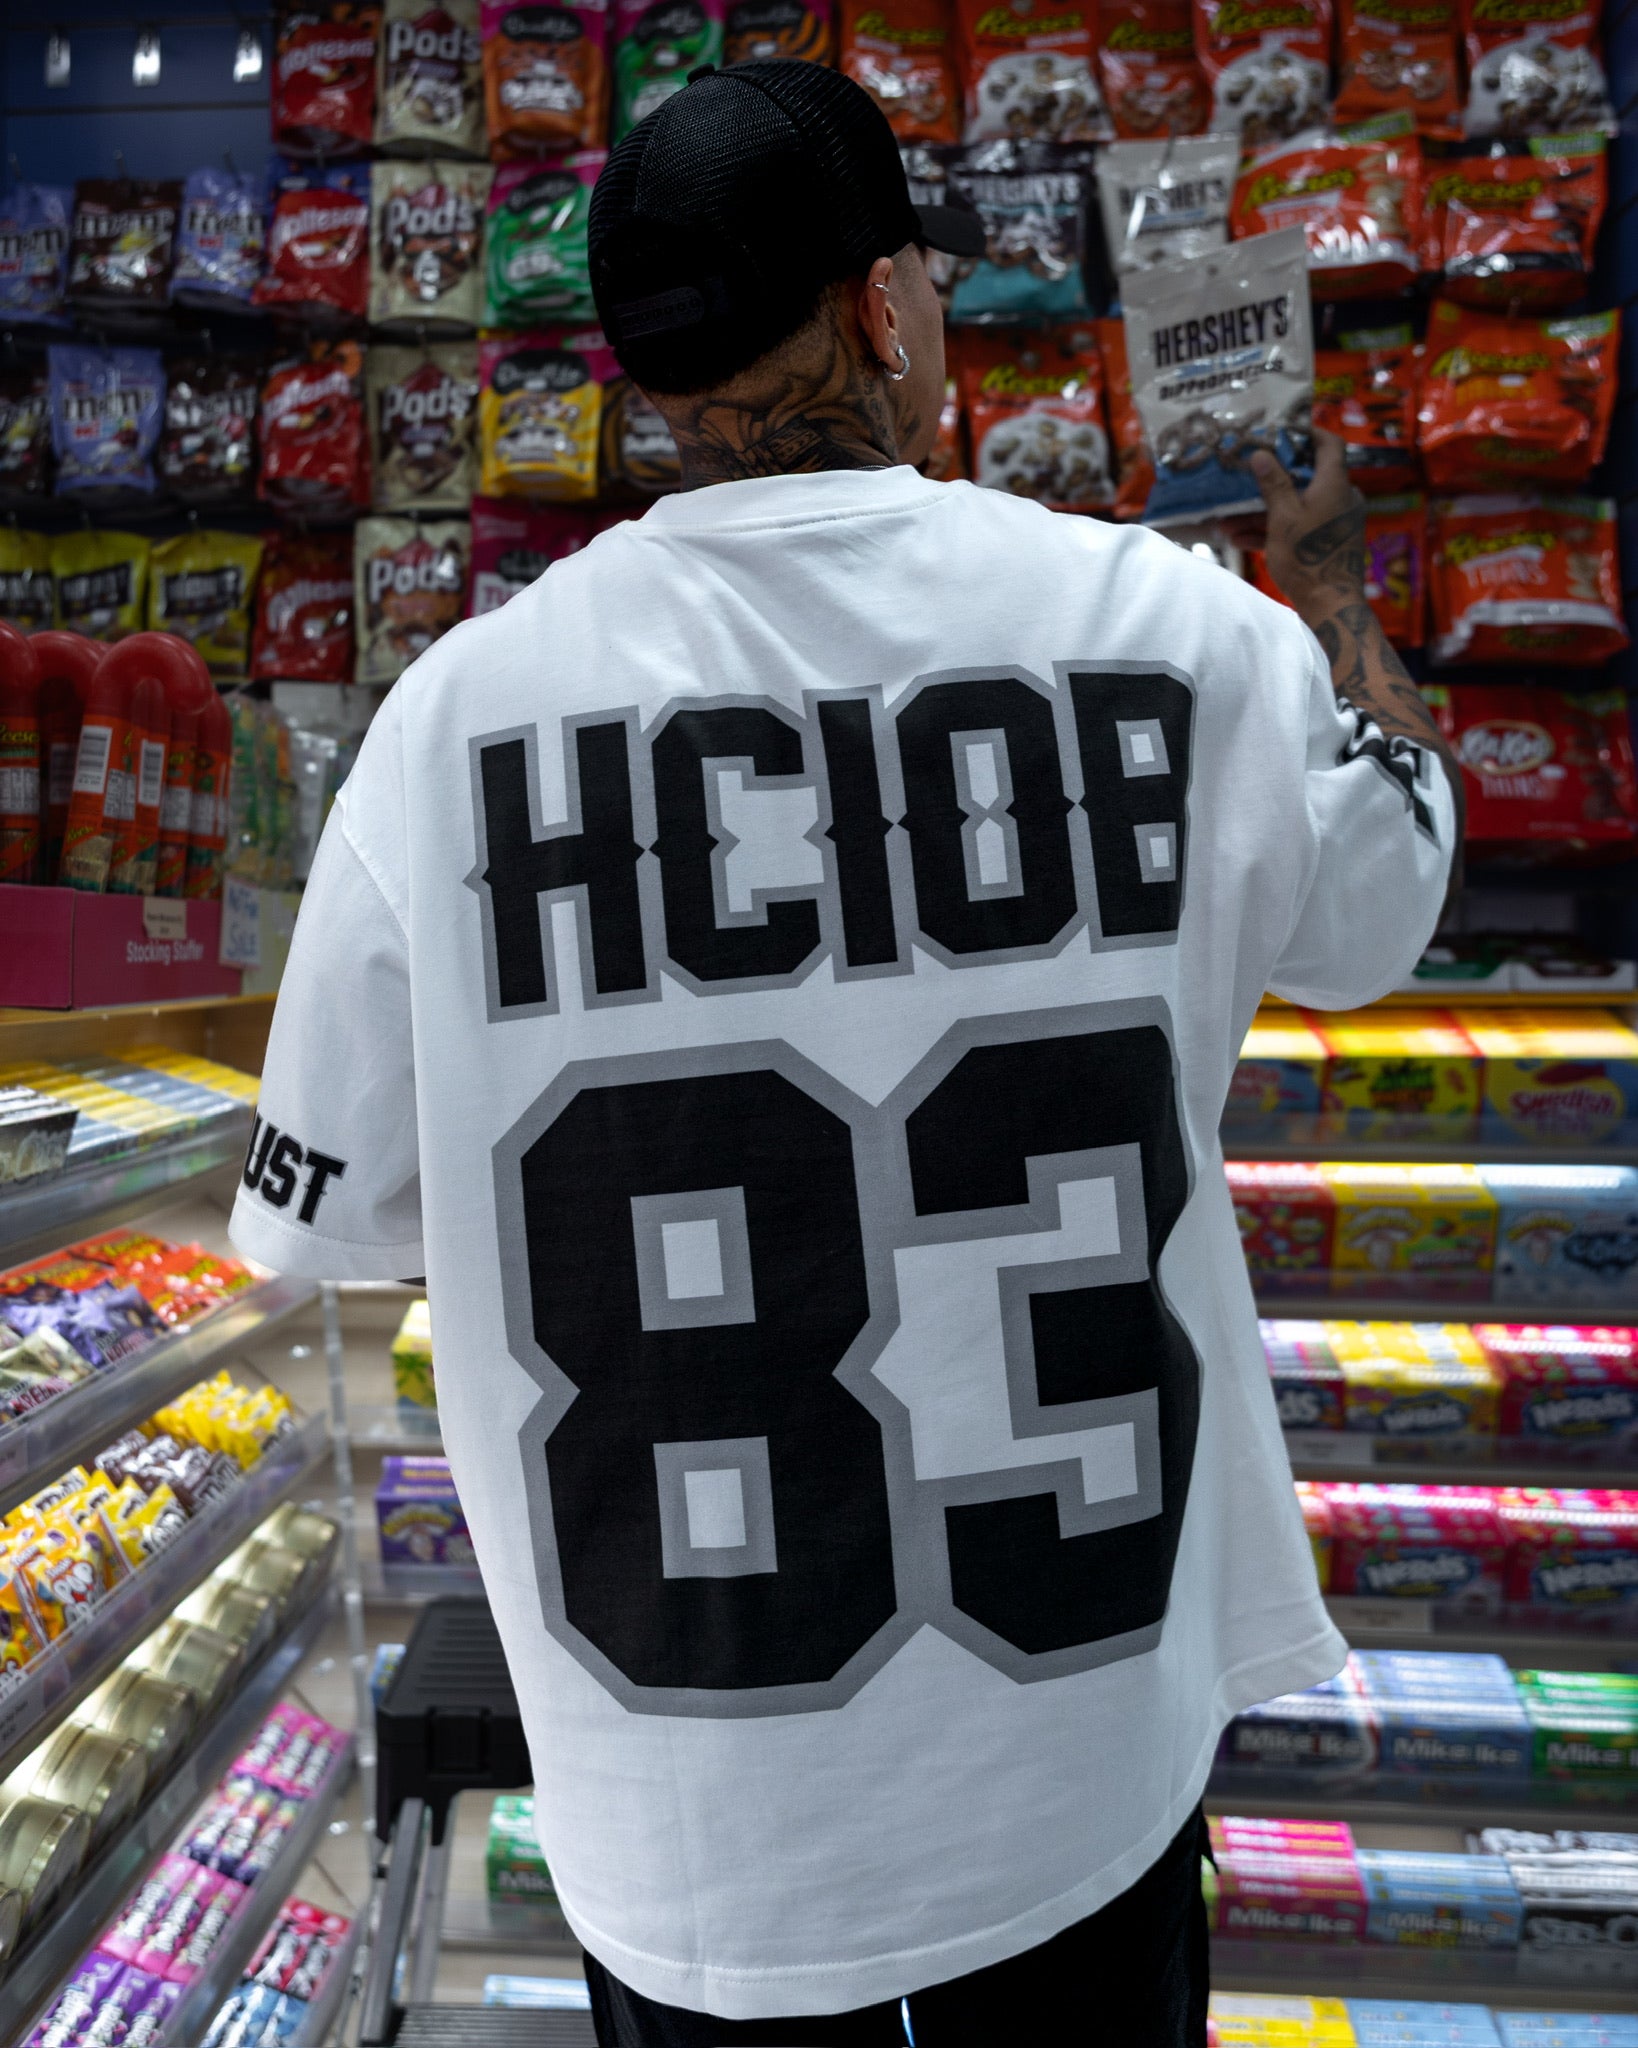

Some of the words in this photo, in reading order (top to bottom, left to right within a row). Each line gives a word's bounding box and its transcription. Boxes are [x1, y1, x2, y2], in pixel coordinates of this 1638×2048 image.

[388, 21, 481, 63] Pods
[389, 199, 476, 246] Pods
[1154, 297, 1287, 368] HERSHEY'S
[380, 379, 474, 432] Pods
[490, 994, 1205, 1719] 83
